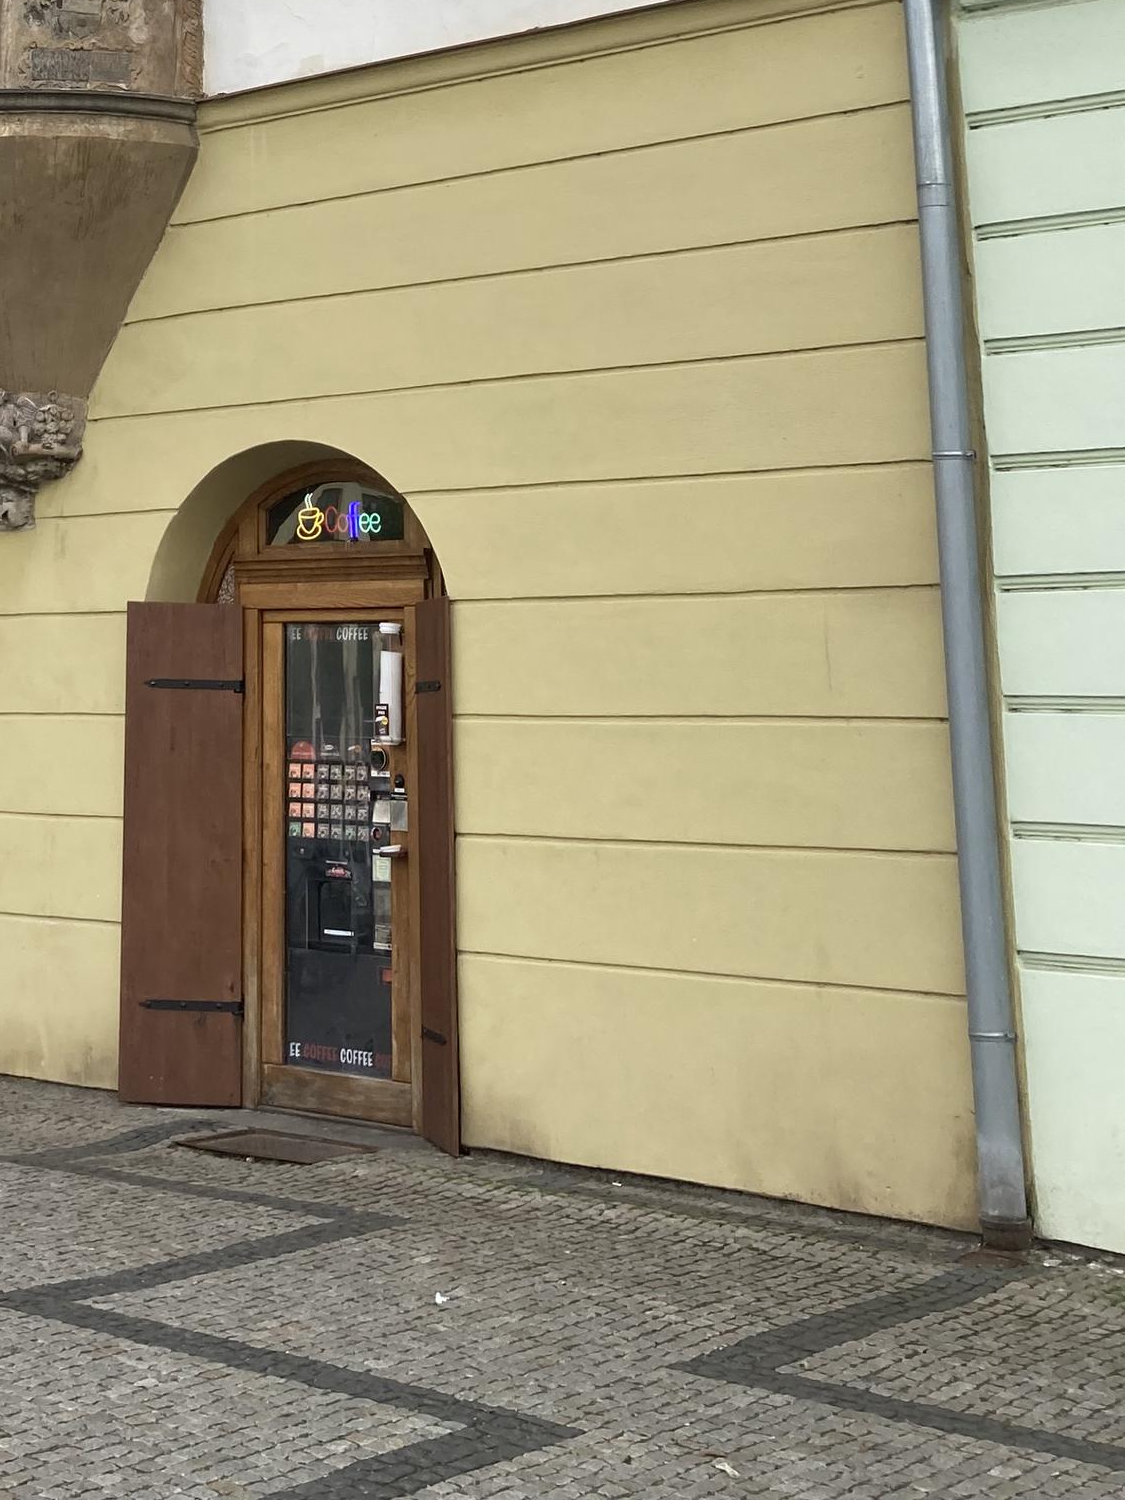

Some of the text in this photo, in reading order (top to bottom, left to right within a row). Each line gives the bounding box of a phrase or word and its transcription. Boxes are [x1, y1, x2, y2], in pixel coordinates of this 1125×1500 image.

[325, 500, 381, 538] Coffee
[336, 627, 368, 640] COFFEE
[340, 1048, 373, 1067] COFFEE
